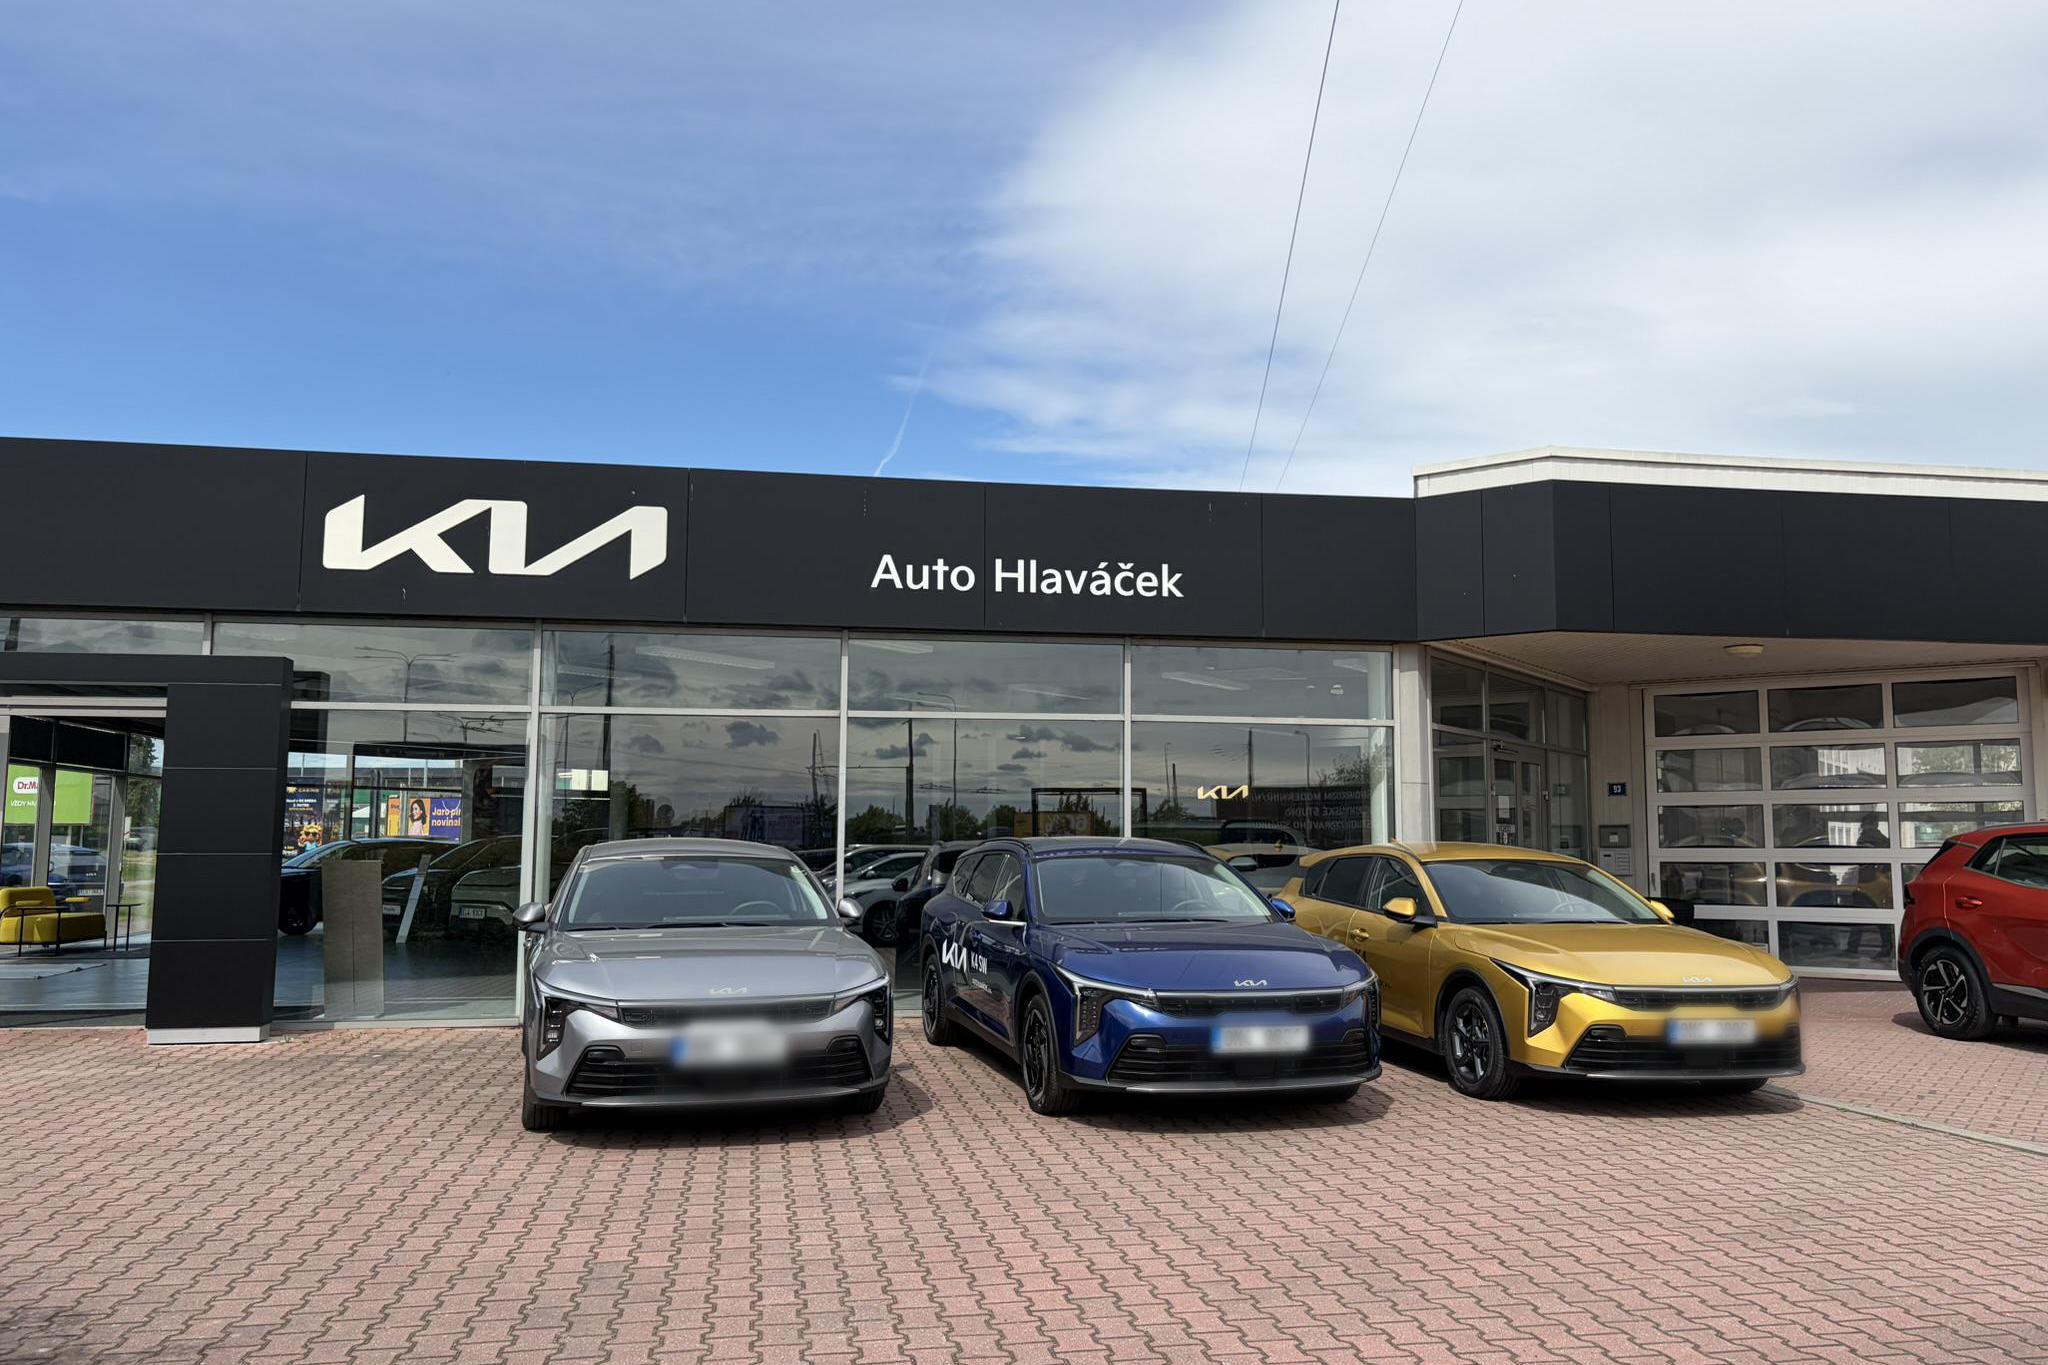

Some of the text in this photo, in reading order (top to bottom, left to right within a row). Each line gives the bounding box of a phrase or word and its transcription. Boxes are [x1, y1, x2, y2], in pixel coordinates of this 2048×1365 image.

[322, 493, 669, 580] KIA
[870, 554, 1185, 600] Auto Hlaváček
[1197, 784, 1249, 800] KIA
[431, 807, 450, 816] Jaro
[942, 938, 967, 973] KIA
[1233, 979, 1268, 987] KIA
